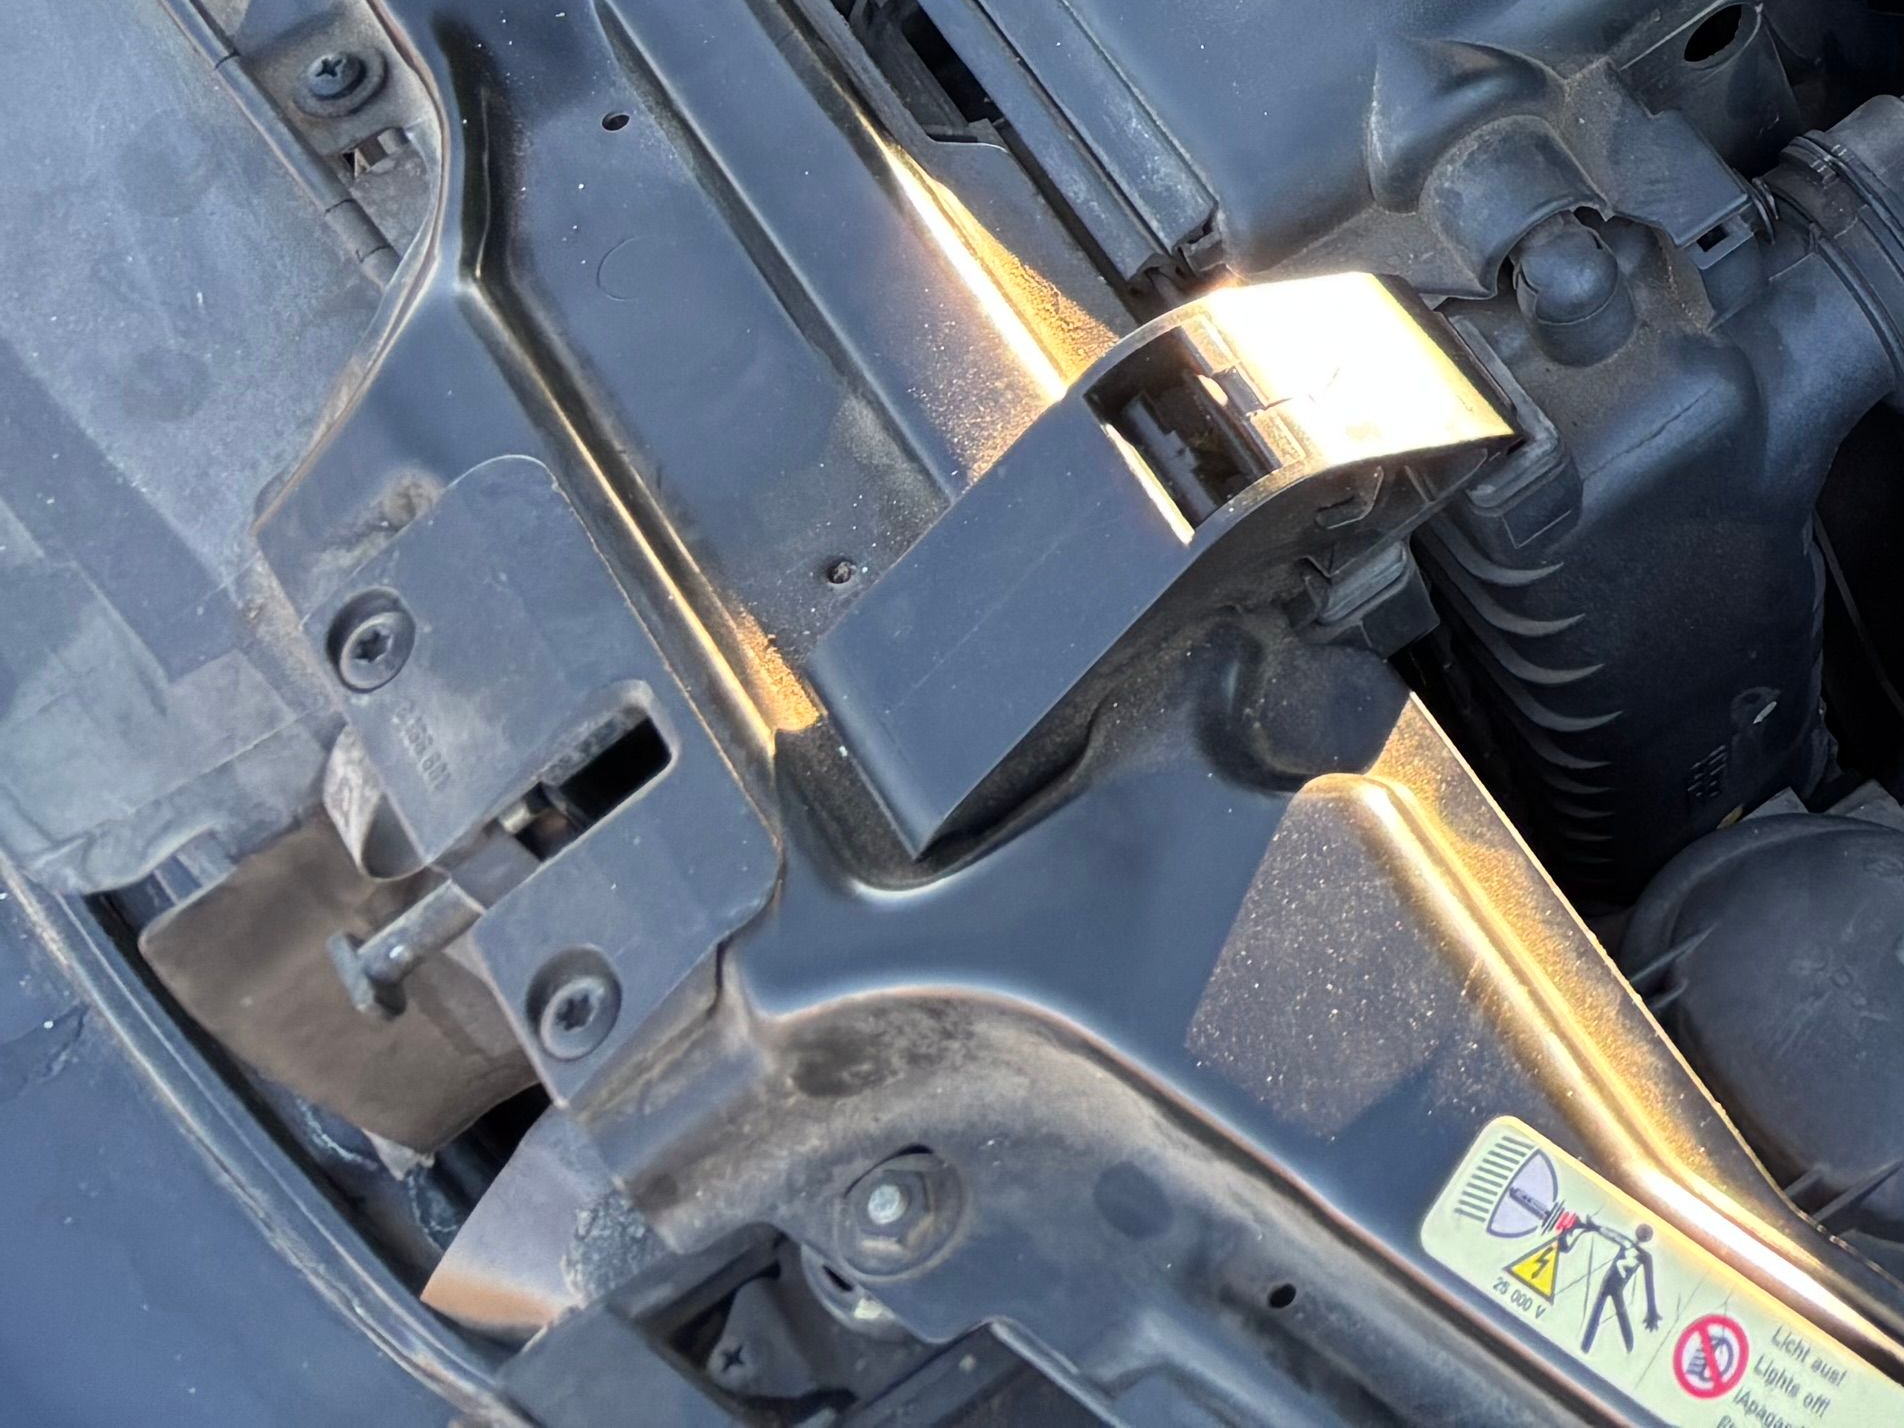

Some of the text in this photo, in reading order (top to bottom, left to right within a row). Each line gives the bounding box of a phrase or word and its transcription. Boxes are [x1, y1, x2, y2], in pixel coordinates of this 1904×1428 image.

[1492, 1275, 1547, 1320] 25 000 V
[1771, 1324, 1809, 1364] Licht
[1753, 1353, 1802, 1399] Lights
